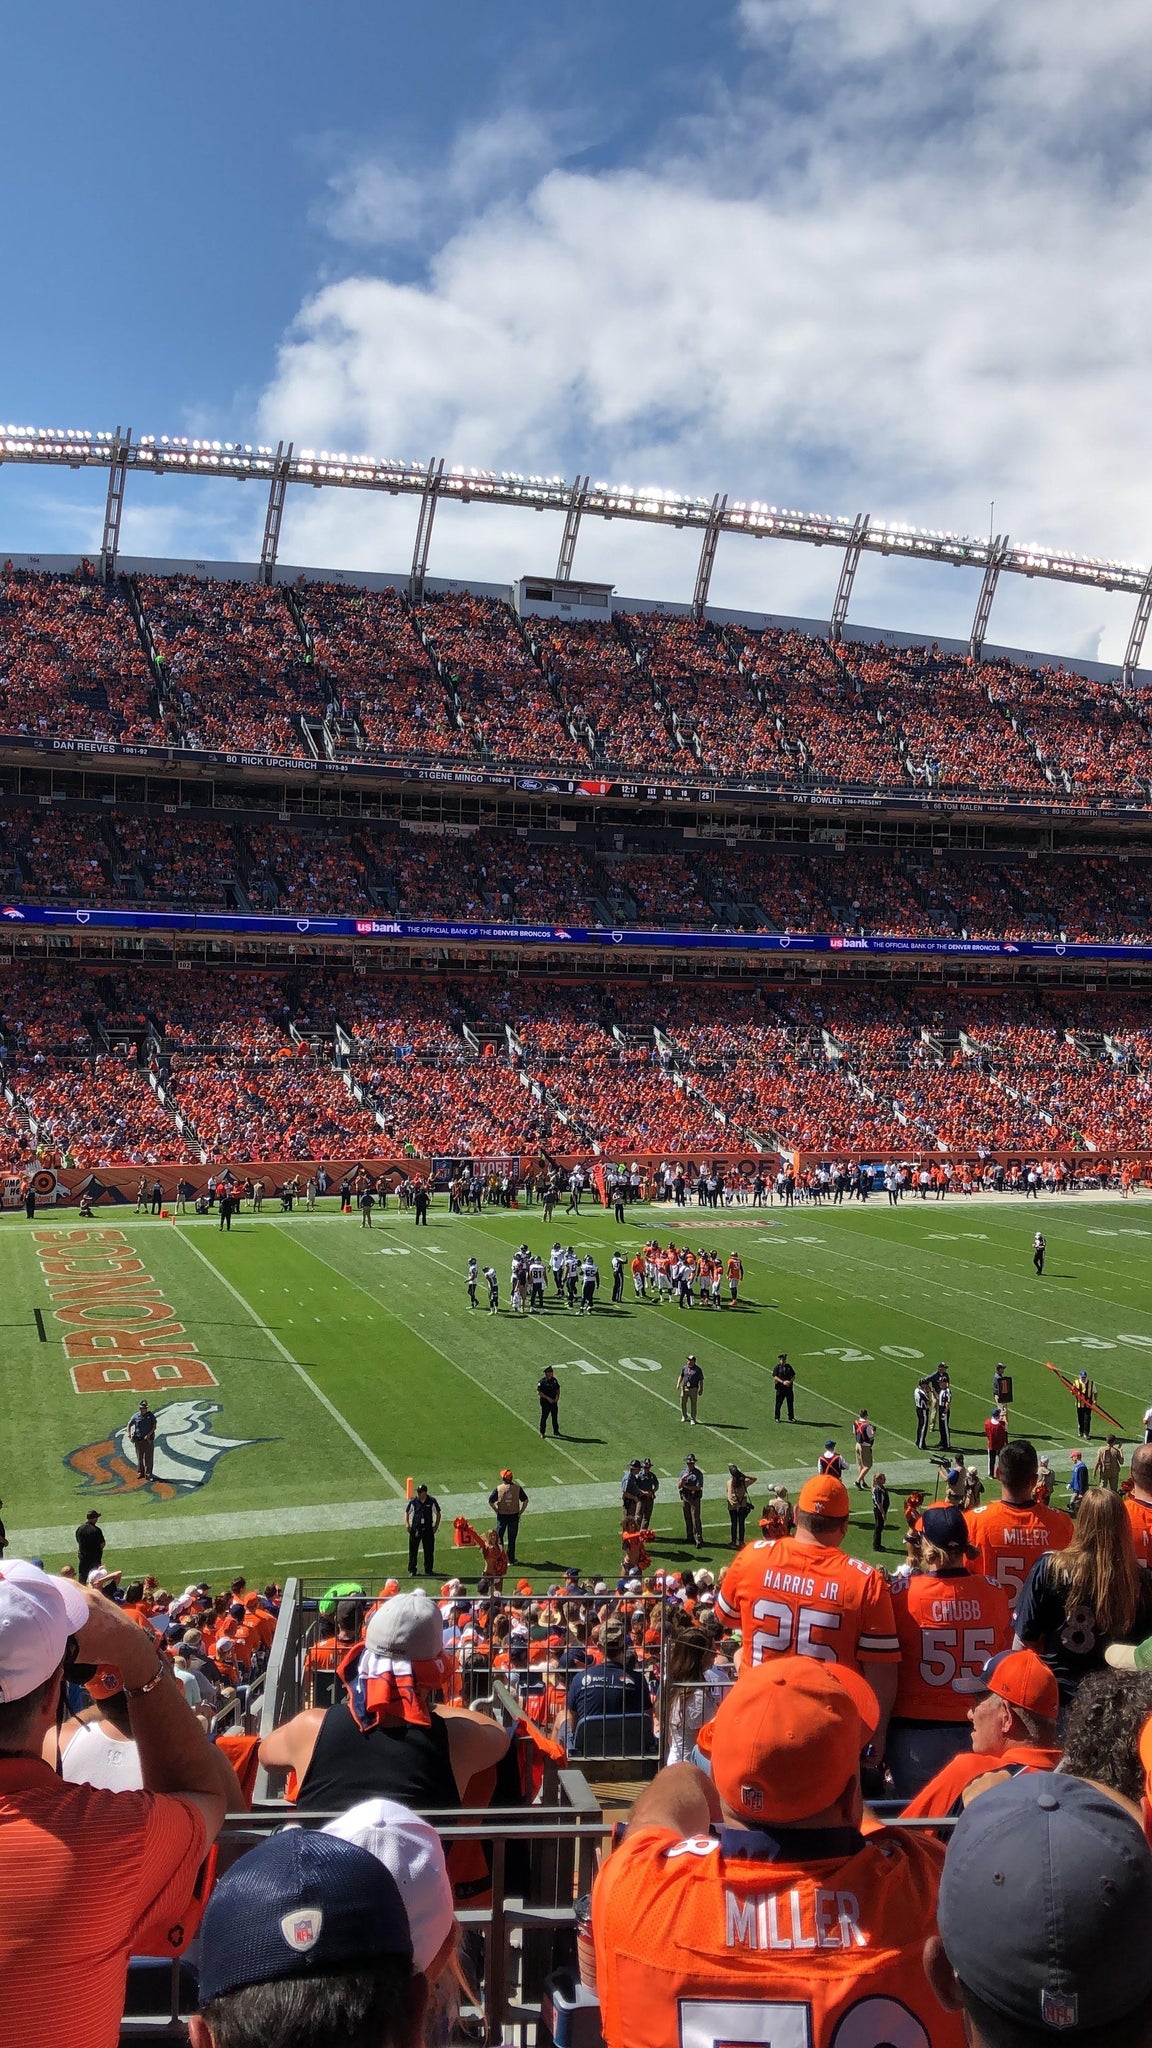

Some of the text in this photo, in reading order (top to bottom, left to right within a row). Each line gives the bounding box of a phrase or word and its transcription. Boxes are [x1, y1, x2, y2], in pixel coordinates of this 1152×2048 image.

[53, 741, 74, 751] DAN
[77, 743, 116, 754] REEVES
[226, 755, 237, 763] 80
[241, 757, 264, 766] RICK
[266, 759, 317, 770] UPCHURCH
[429, 772, 453, 781] GENE
[454, 773, 484, 783] MINGO
[811, 796, 842, 804] BOWLEN
[737, 1160, 775, 1178] OF
[533, 1270, 542, 1278] 81
[30, 1228, 220, 1394] BRONCOS
[823, 1345, 925, 1361] 20
[567, 1357, 662, 1375] 10
[1003, 1528, 1050, 1546] MILLER
[763, 1569, 840, 1602] HARRIS JR
[931, 1599, 981, 1623] CHUBB
[751, 1599, 842, 1668] 25
[919, 1628, 995, 1688] 55
[725, 1888, 867, 1950] MILLER
